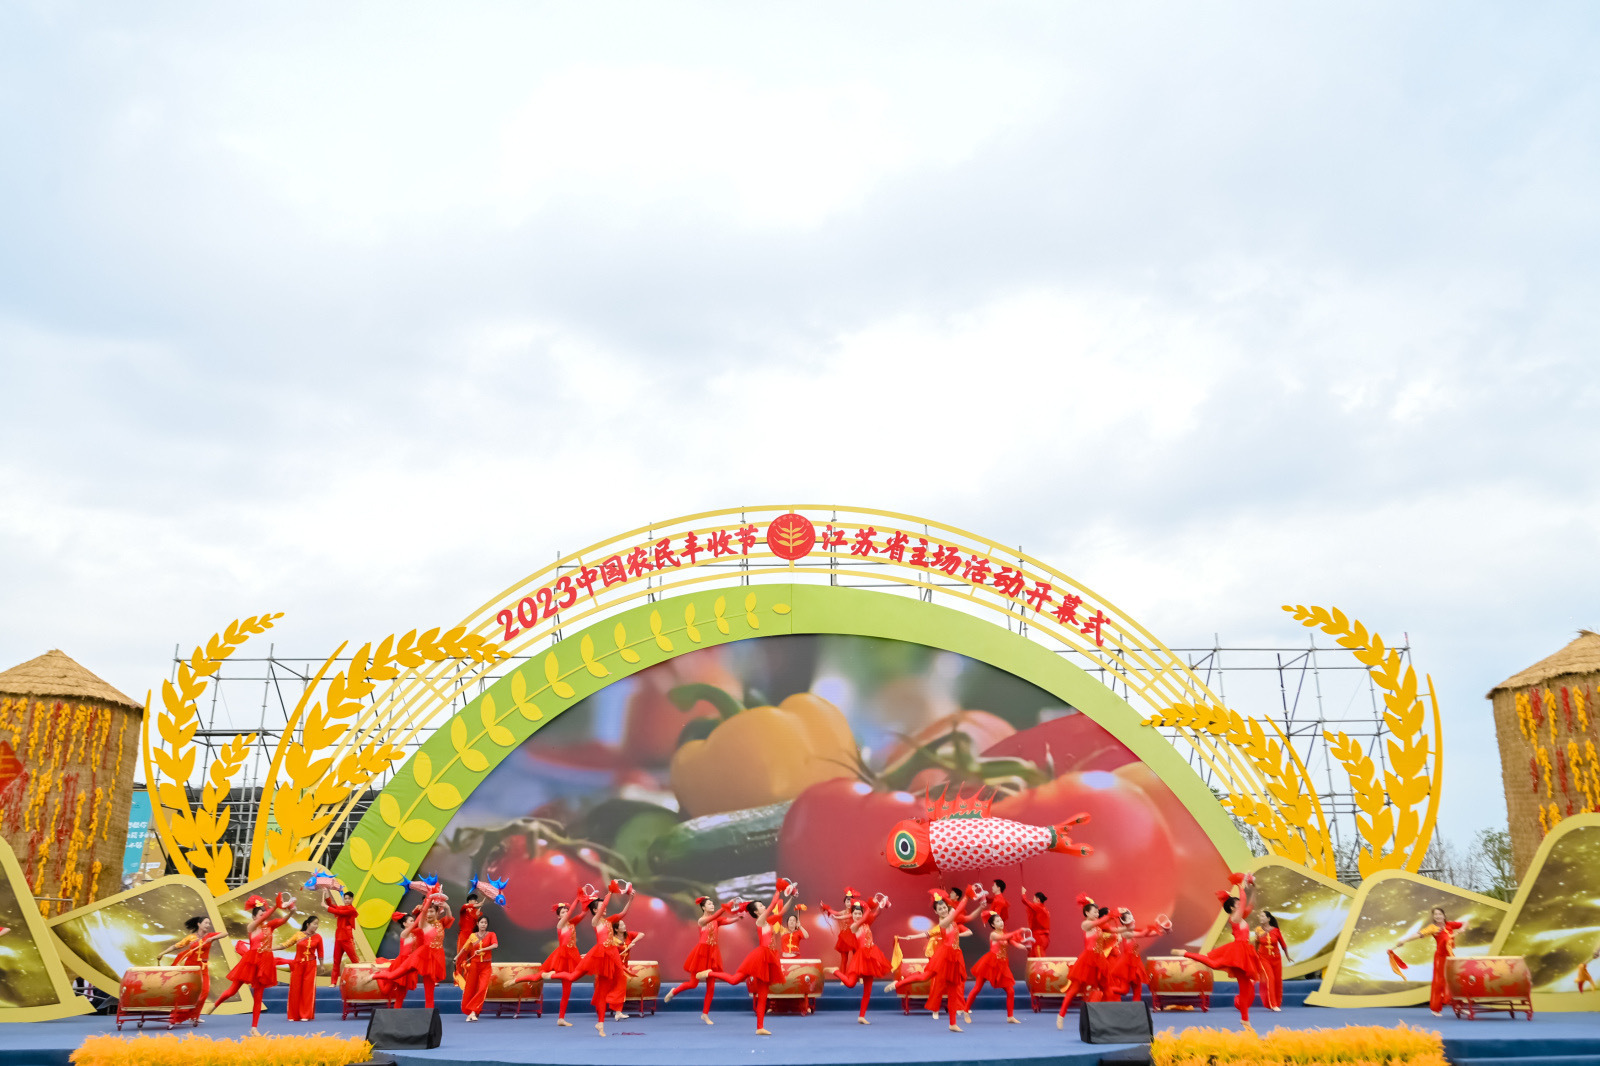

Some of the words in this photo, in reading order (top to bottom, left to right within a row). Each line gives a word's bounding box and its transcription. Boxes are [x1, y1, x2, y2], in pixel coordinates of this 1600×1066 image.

[496, 524, 759, 642] 2023中国农民丰收节
[821, 524, 1111, 647] 江苏省主场活动开幕式
